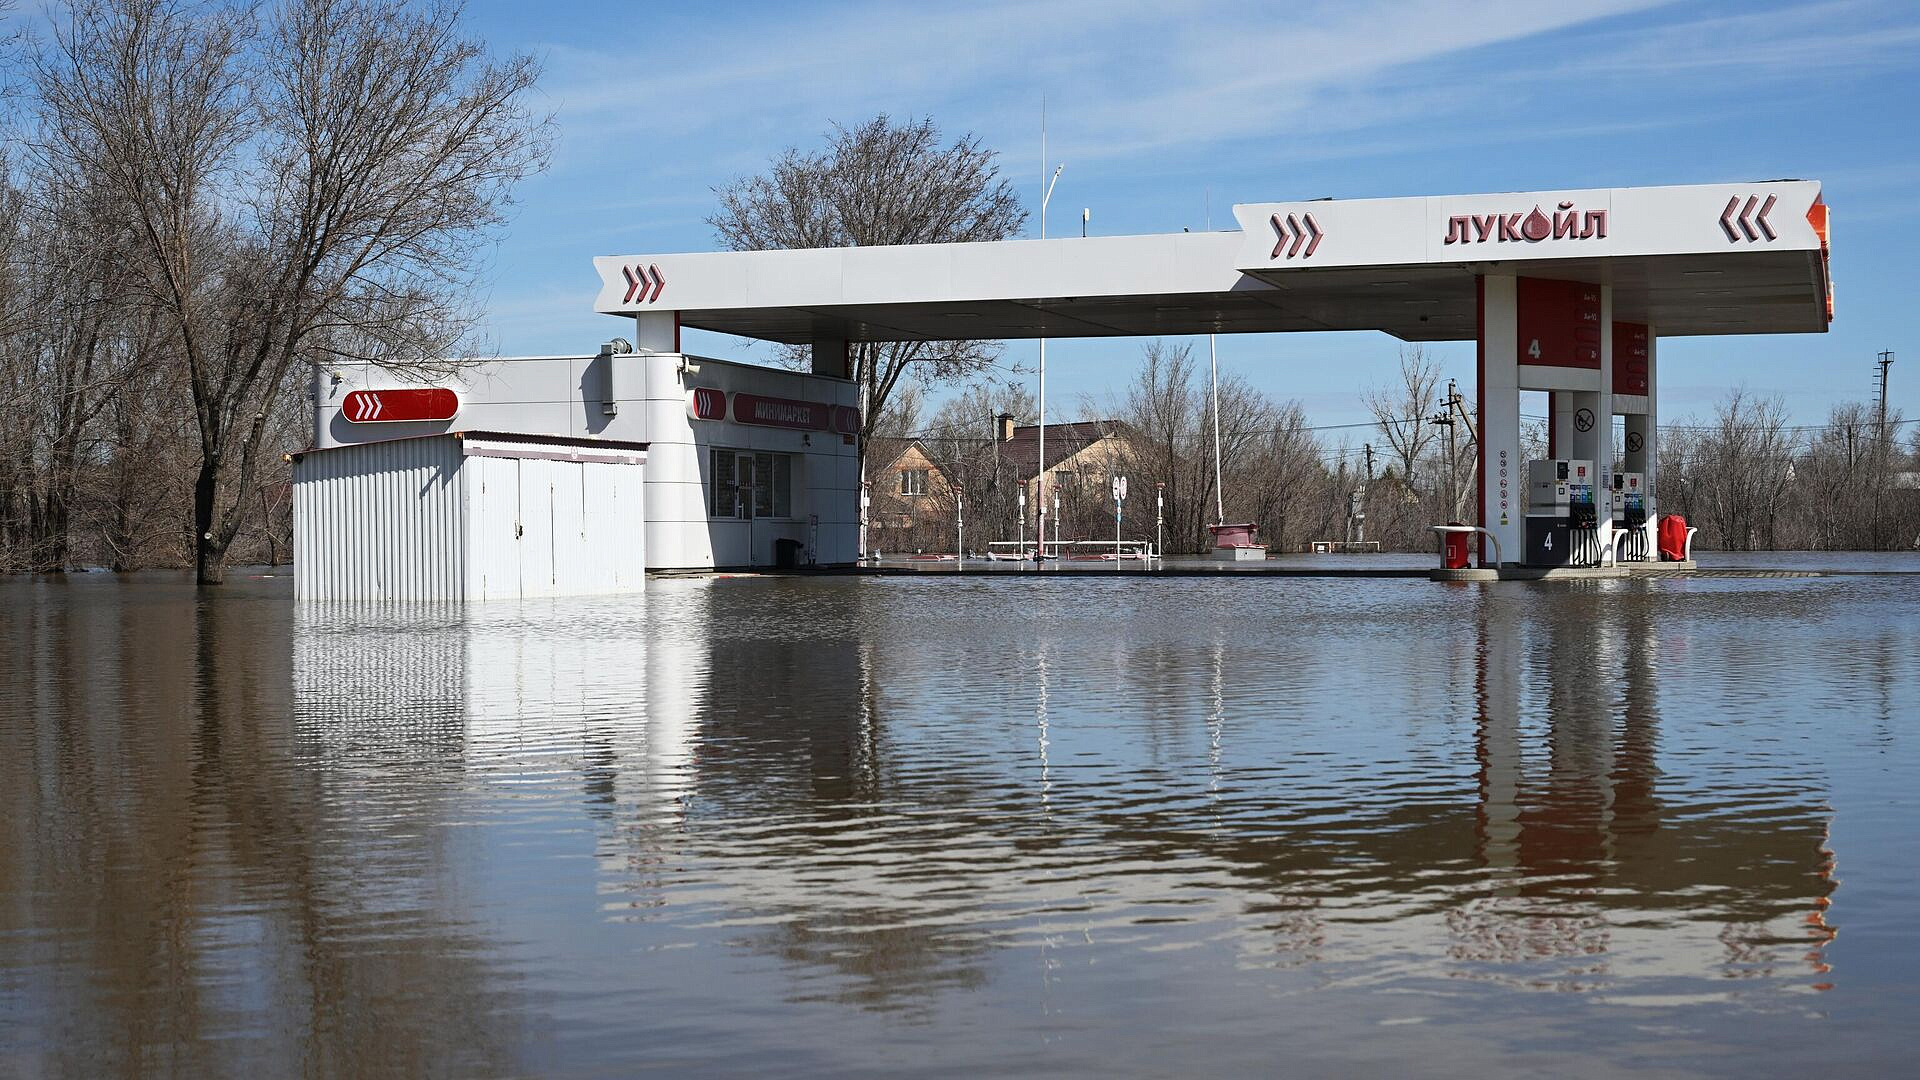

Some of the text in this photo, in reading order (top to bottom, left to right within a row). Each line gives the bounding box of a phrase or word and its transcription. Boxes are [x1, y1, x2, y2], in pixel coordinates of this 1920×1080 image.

[1444, 201, 1607, 245] ЛУКОЙЛ
[1528, 339, 1541, 359] 4
[755, 401, 810, 424] МИНИМАРКЕТ
[1544, 532, 1553, 551] 4
